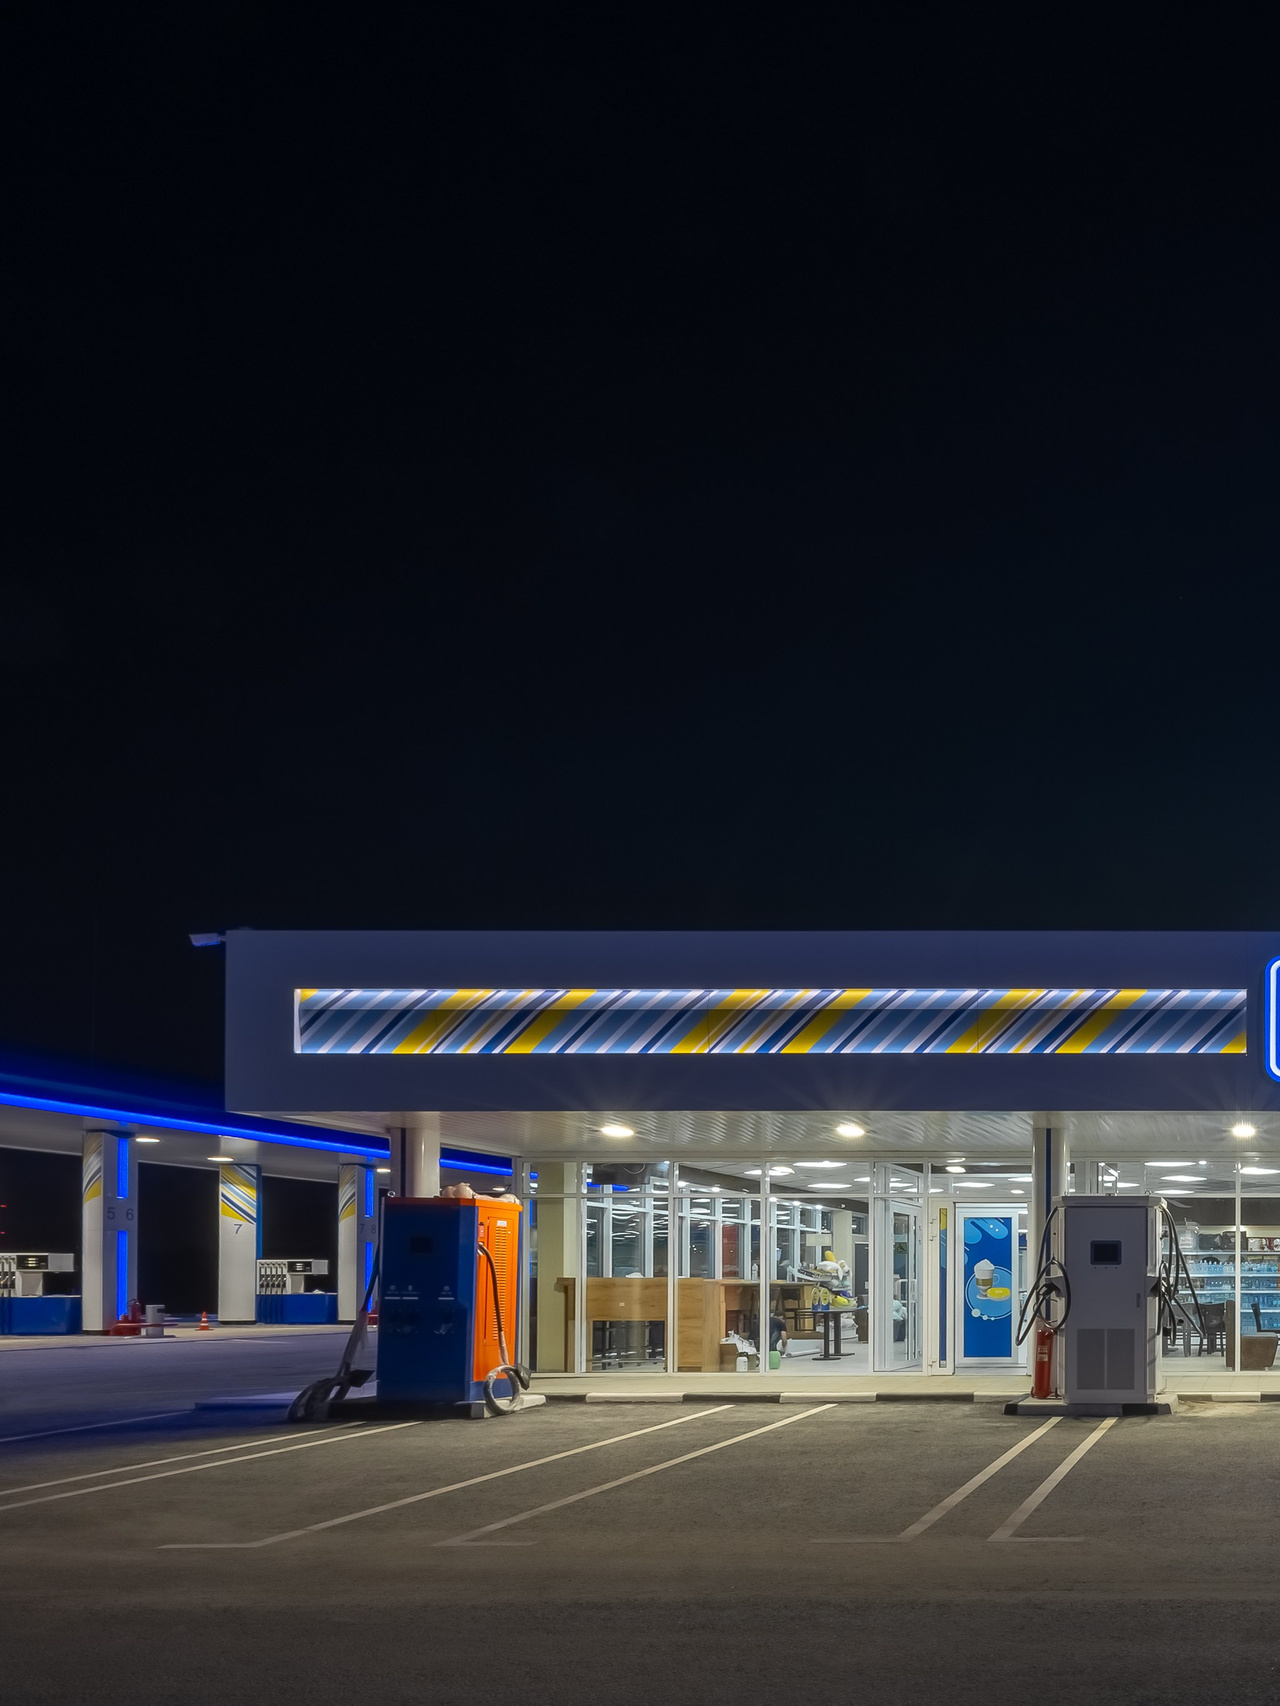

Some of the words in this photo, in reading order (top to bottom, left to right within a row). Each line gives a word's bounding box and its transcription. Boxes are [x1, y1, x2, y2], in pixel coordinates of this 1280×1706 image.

[107, 1207, 116, 1220] 5
[126, 1208, 135, 1221] 6
[233, 1223, 243, 1235] 7
[359, 1224, 365, 1235] 7
[371, 1225, 377, 1235] 8
